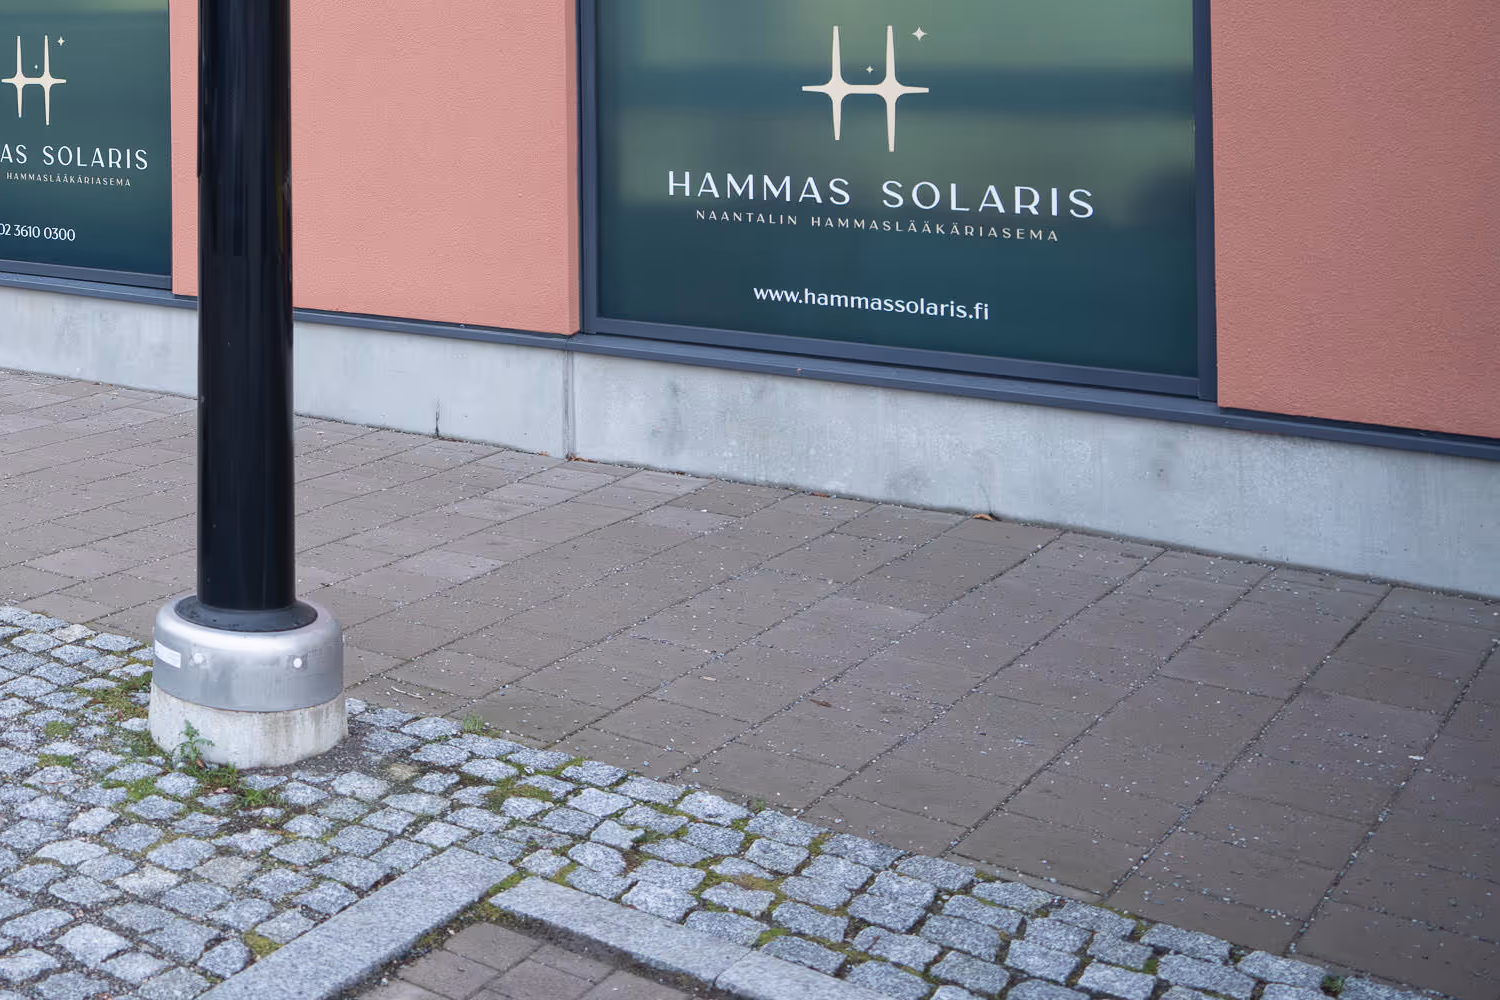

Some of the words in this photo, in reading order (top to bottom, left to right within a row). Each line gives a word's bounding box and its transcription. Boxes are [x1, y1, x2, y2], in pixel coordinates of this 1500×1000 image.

[42, 145, 148, 170] SOLARIS
[6, 172, 131, 187] HAMMASLÄÄKÄRIASEMA
[668, 170, 851, 206] HAMMAS
[882, 180, 1095, 219] SOLARIS
[13, 225, 40, 239] 3610
[43, 227, 76, 242] 0300
[696, 209, 798, 225] NAANTALIN
[811, 216, 1059, 242] HAMMASLÄÄKÄRIASEMA
[753, 287, 989, 320] www.hammassolaris.fi
